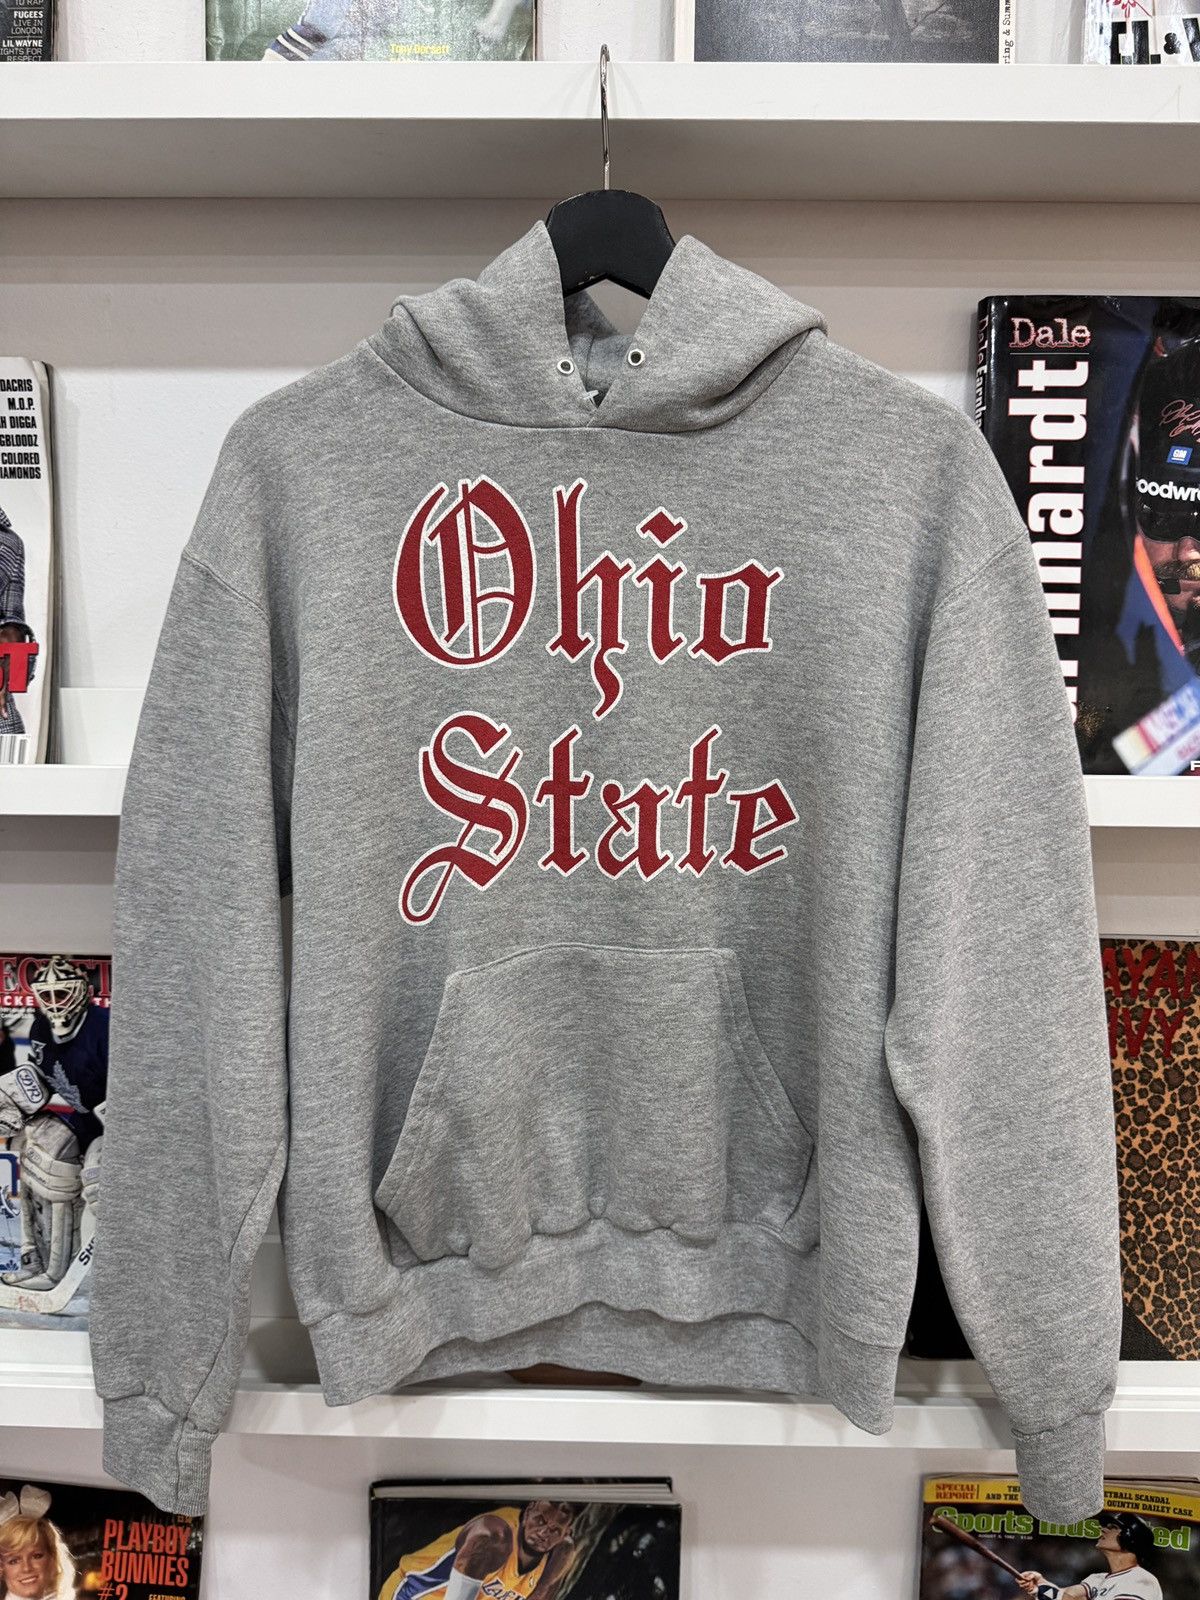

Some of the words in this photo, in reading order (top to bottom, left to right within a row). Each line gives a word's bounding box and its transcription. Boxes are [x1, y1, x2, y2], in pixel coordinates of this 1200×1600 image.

[13, 10, 44, 18] FUGEES
[11, 27, 43, 35] LONDON
[390, 43, 412, 56] Tony
[1003, 40, 1014, 64] ring
[1008, 317, 1091, 348] Dale
[7, 397, 35, 410] M.O.P.
[9, 416, 37, 429] DIGGA
[1, 452, 40, 465] COLORED
[1136, 478, 1200, 502] oodwr
[392, 474, 785, 720] Ohio
[399, 711, 800, 926] State
[935, 1483, 976, 1492] SPECIAL
[935, 1491, 974, 1500] REPORT
[1004, 1493, 1019, 1501] THE
[1106, 1500, 1140, 1510] QUINTIN
[1141, 1504, 1171, 1514] DAILEY
[1172, 1508, 1193, 1517] CASE
[1103, 1490, 1133, 1500] ETBALL
[1135, 1493, 1171, 1505] SCANDAL
[932, 1506, 1034, 1535] Sports
[103, 1519, 192, 1556] PLAYBOY
[101, 1550, 189, 1588] BUNNIES
